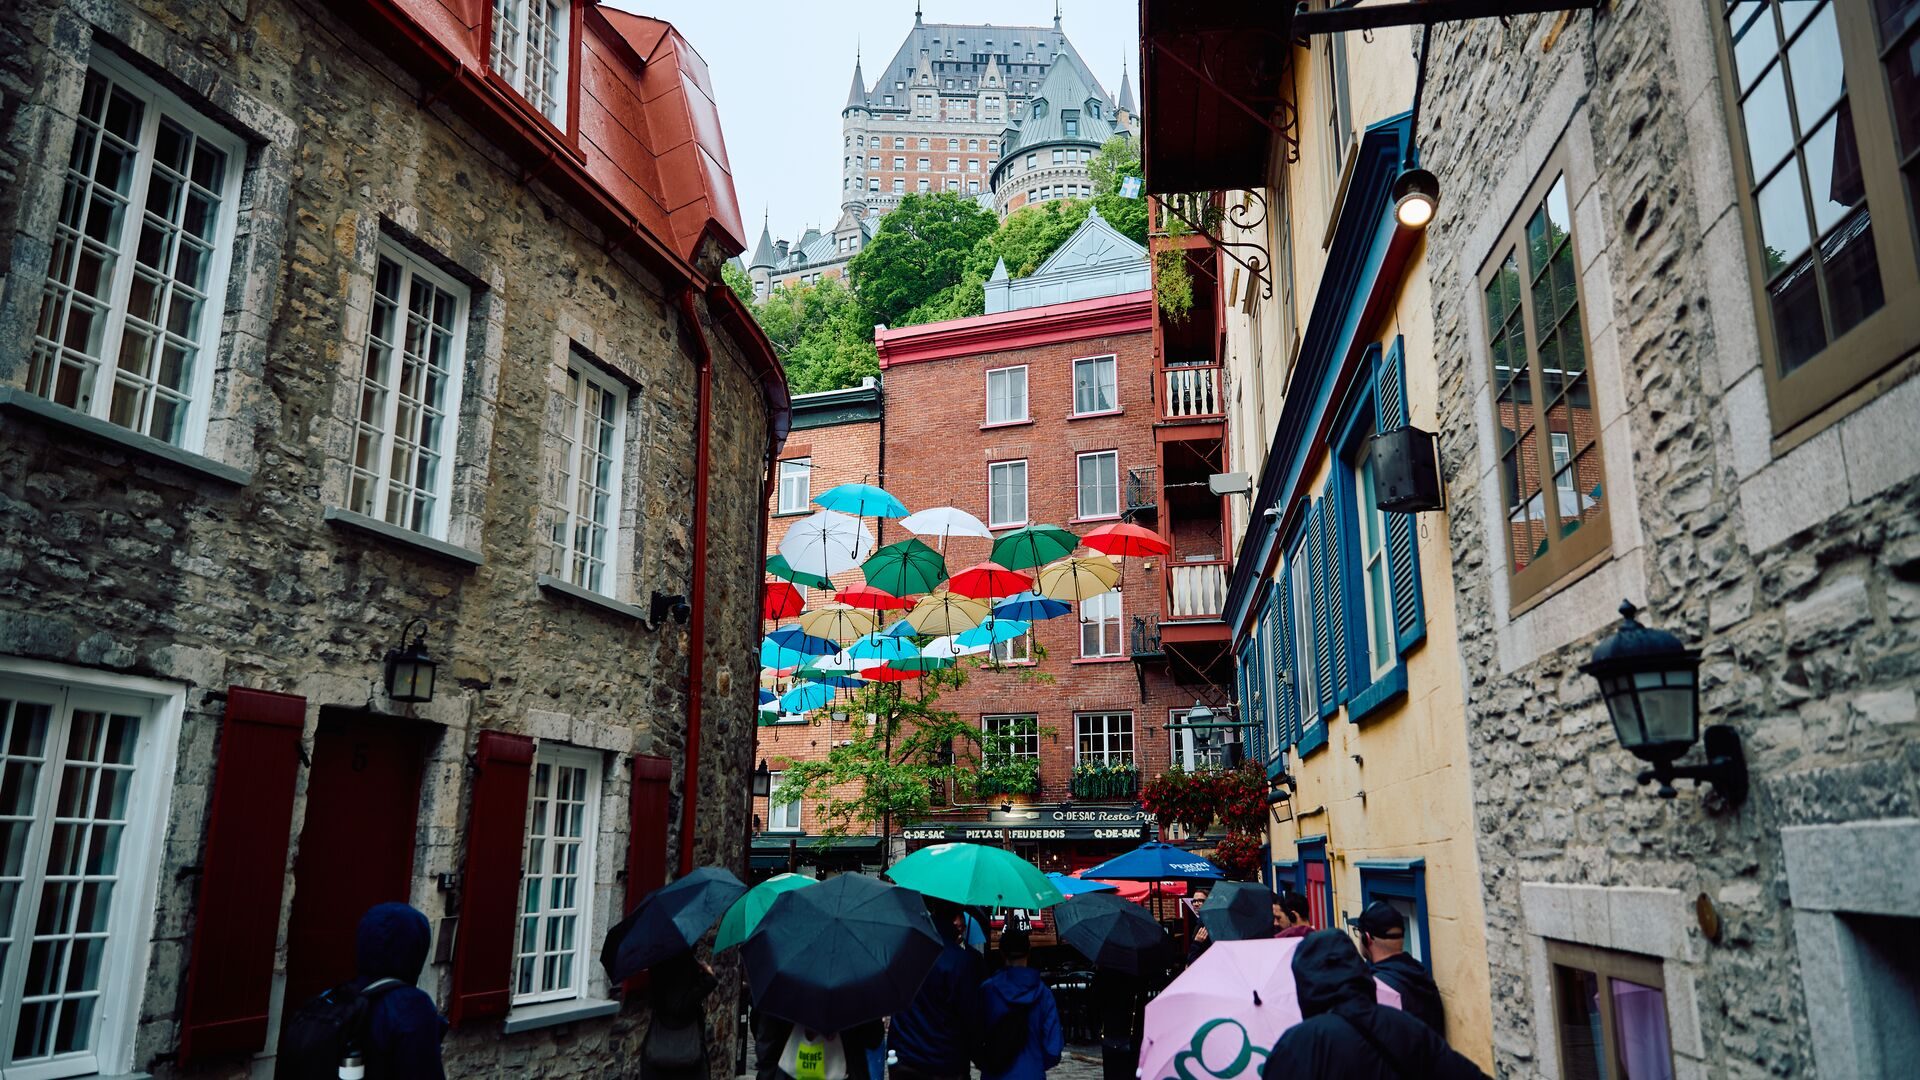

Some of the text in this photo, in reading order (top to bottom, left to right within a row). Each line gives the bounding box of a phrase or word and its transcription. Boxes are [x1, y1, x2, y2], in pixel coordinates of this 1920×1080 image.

[903, 830, 945, 839] Q-DE-SAC
[966, 830, 993, 839] PIZZA
[1012, 829, 1029, 839] FEU
[1029, 829, 1042, 839] DE
[1042, 829, 1066, 839] BOIS
[1094, 829, 1141, 839] Q-DE-SAC
[802, 1061, 817, 1070] CITY
